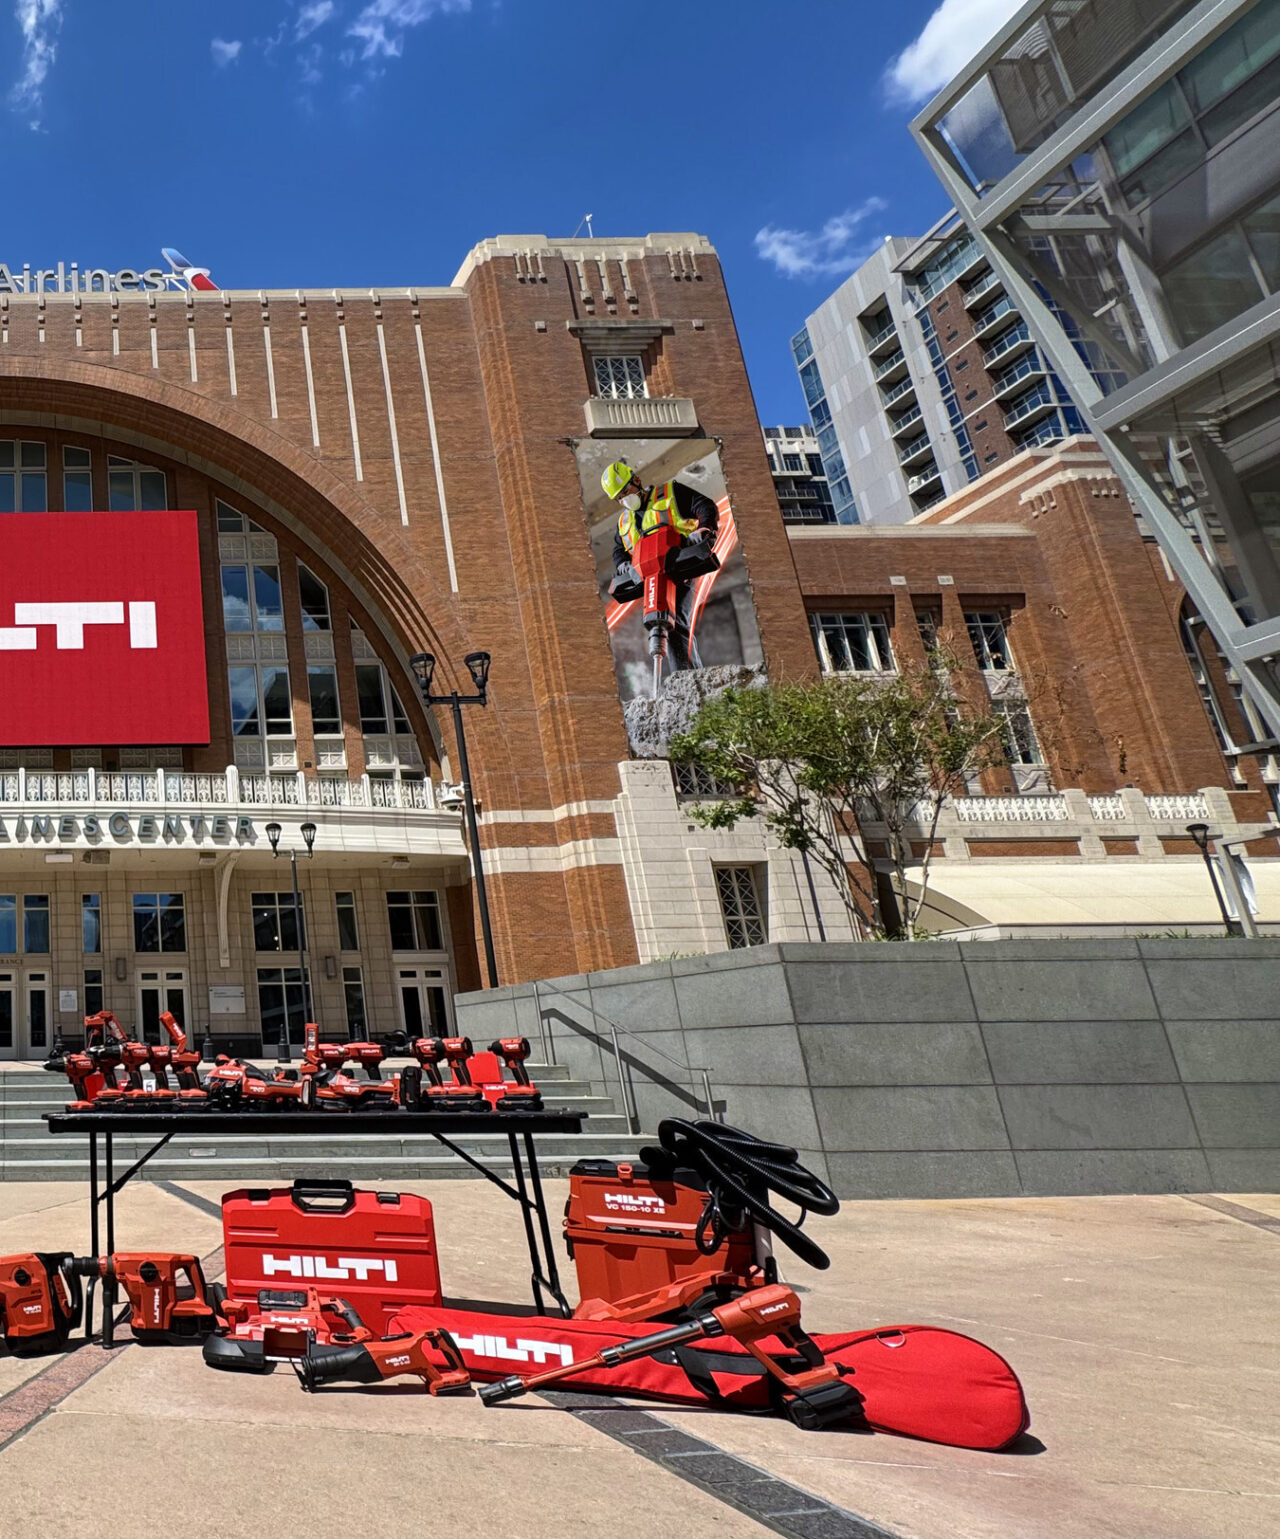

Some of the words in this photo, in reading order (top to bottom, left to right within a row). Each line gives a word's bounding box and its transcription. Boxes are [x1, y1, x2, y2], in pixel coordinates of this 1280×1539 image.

[108, 811, 254, 838] CENTER
[604, 1193, 664, 1207] HILTI
[621, 1205, 651, 1213] 150-10
[263, 1254, 397, 1281] HILTI
[760, 1302, 789, 1315] HILTI
[270, 1316, 308, 1324] HILTI
[448, 1331, 574, 1368] HILTI
